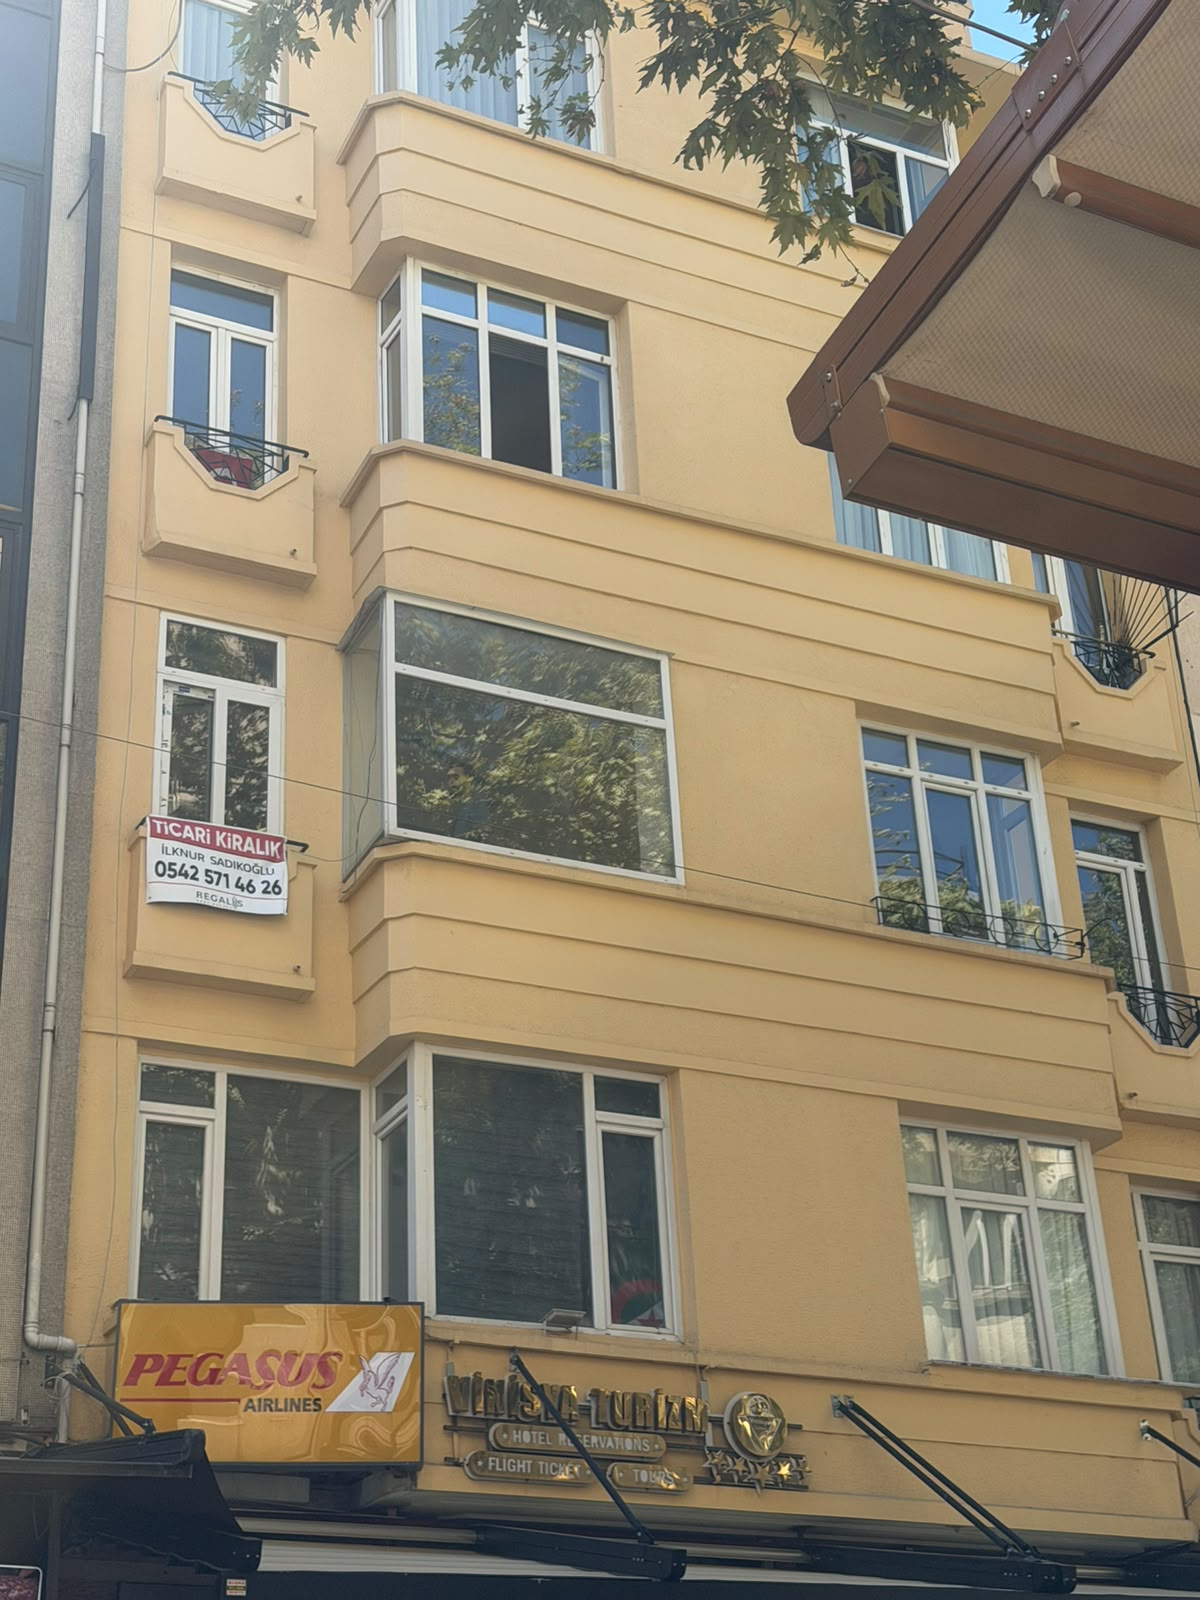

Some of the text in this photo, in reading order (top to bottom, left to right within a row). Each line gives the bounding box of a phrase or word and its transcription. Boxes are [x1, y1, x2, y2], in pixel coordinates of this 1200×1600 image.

[209, 855, 275, 876] SADIKOĞLU
[154, 860, 282, 896] 0542 571 46 26
[122, 1349, 343, 1391] PEGASUS
[243, 1397, 322, 1413] AIRLINES
[512, 1430, 650, 1452] HOTEL RESERVATIONS
[632, 1468, 674, 1486] TOURS
